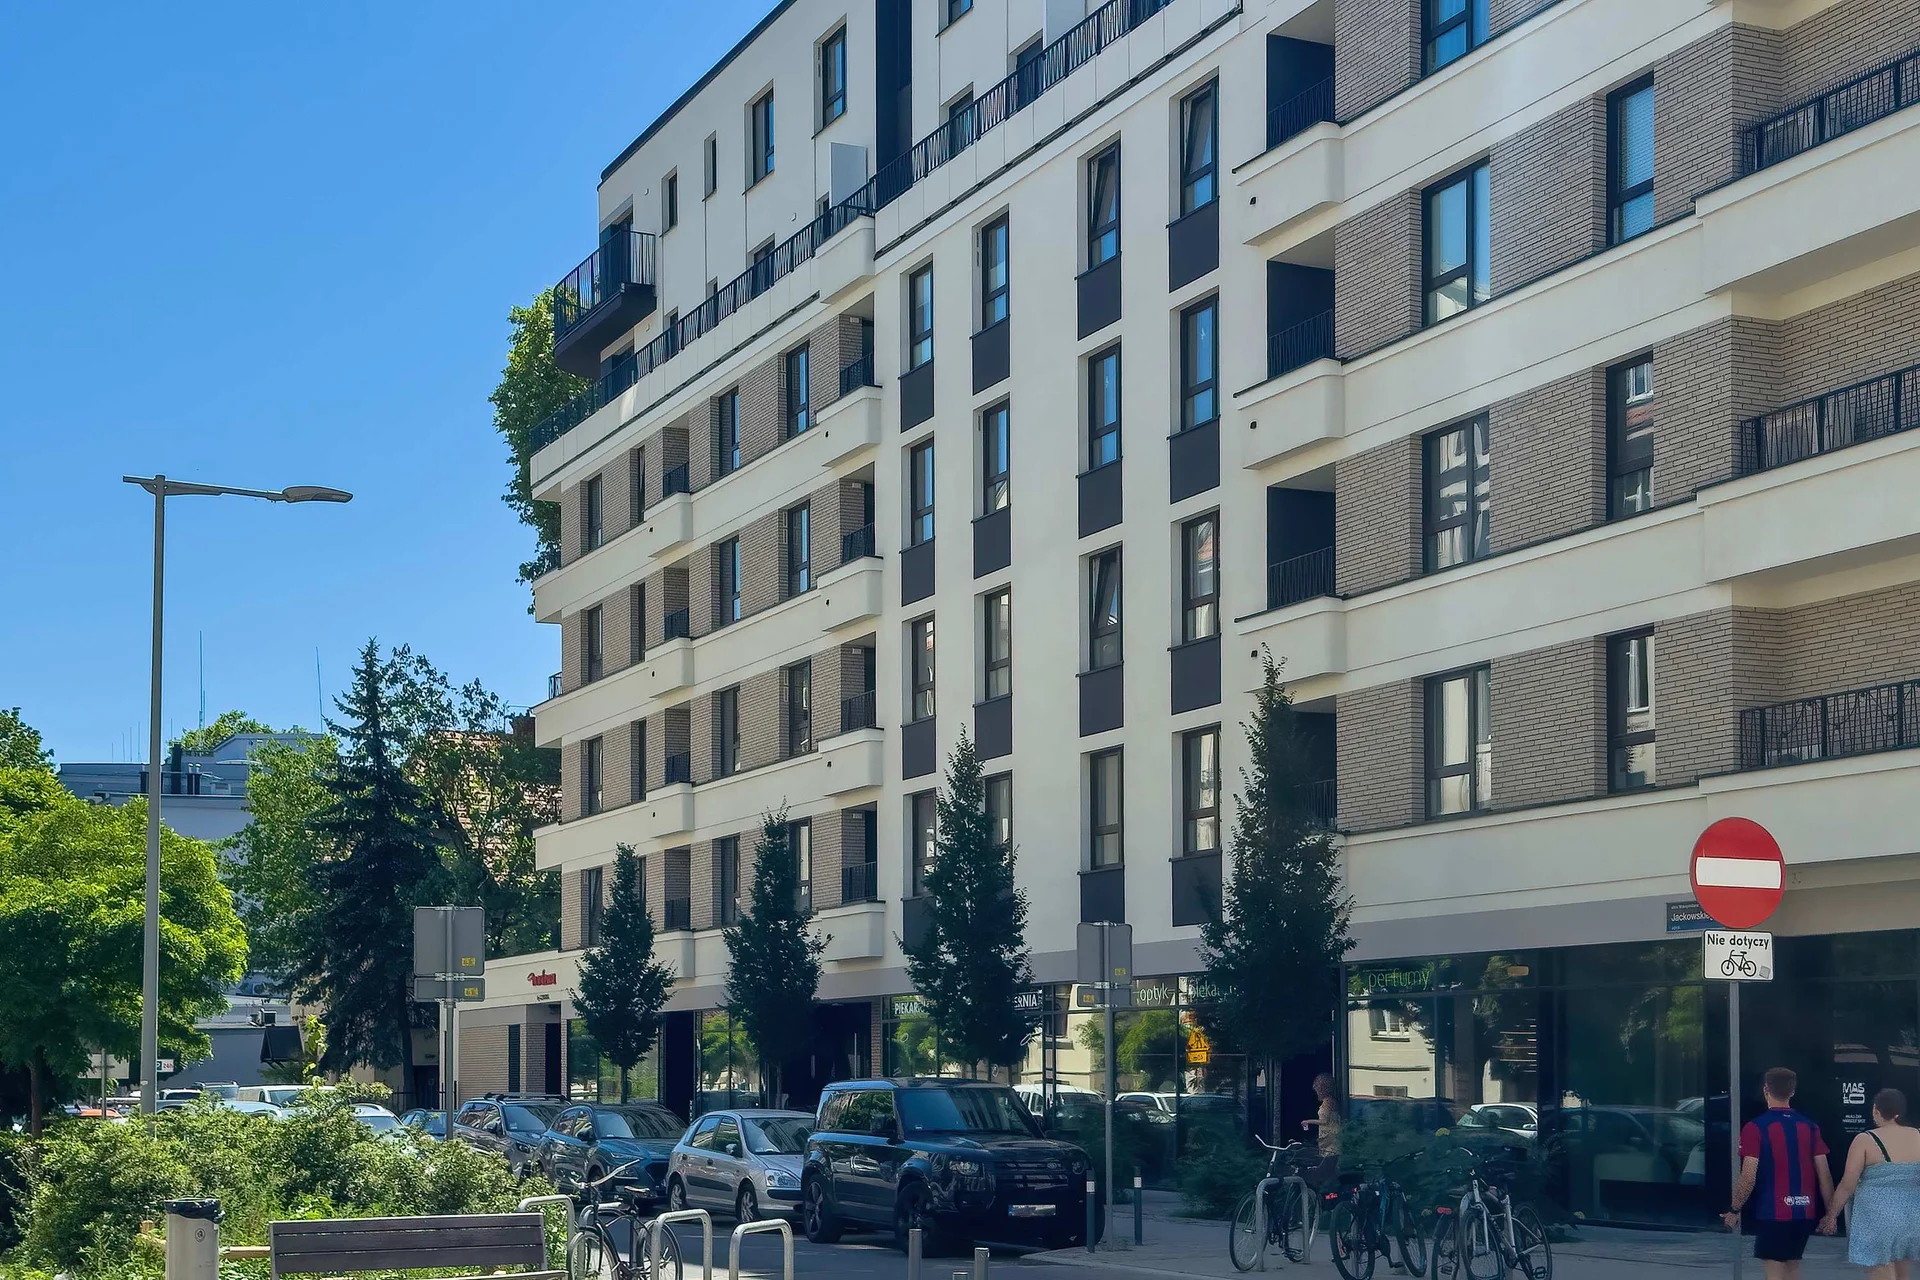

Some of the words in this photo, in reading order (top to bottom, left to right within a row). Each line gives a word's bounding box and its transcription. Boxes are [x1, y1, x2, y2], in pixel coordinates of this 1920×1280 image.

[1707, 933, 1725, 946] Nie
[1729, 935, 1770, 950] dotyczy
[1368, 968, 1430, 993] perfumy
[1140, 982, 1169, 1005] optyk
[1842, 1082, 1865, 1094] MAS
